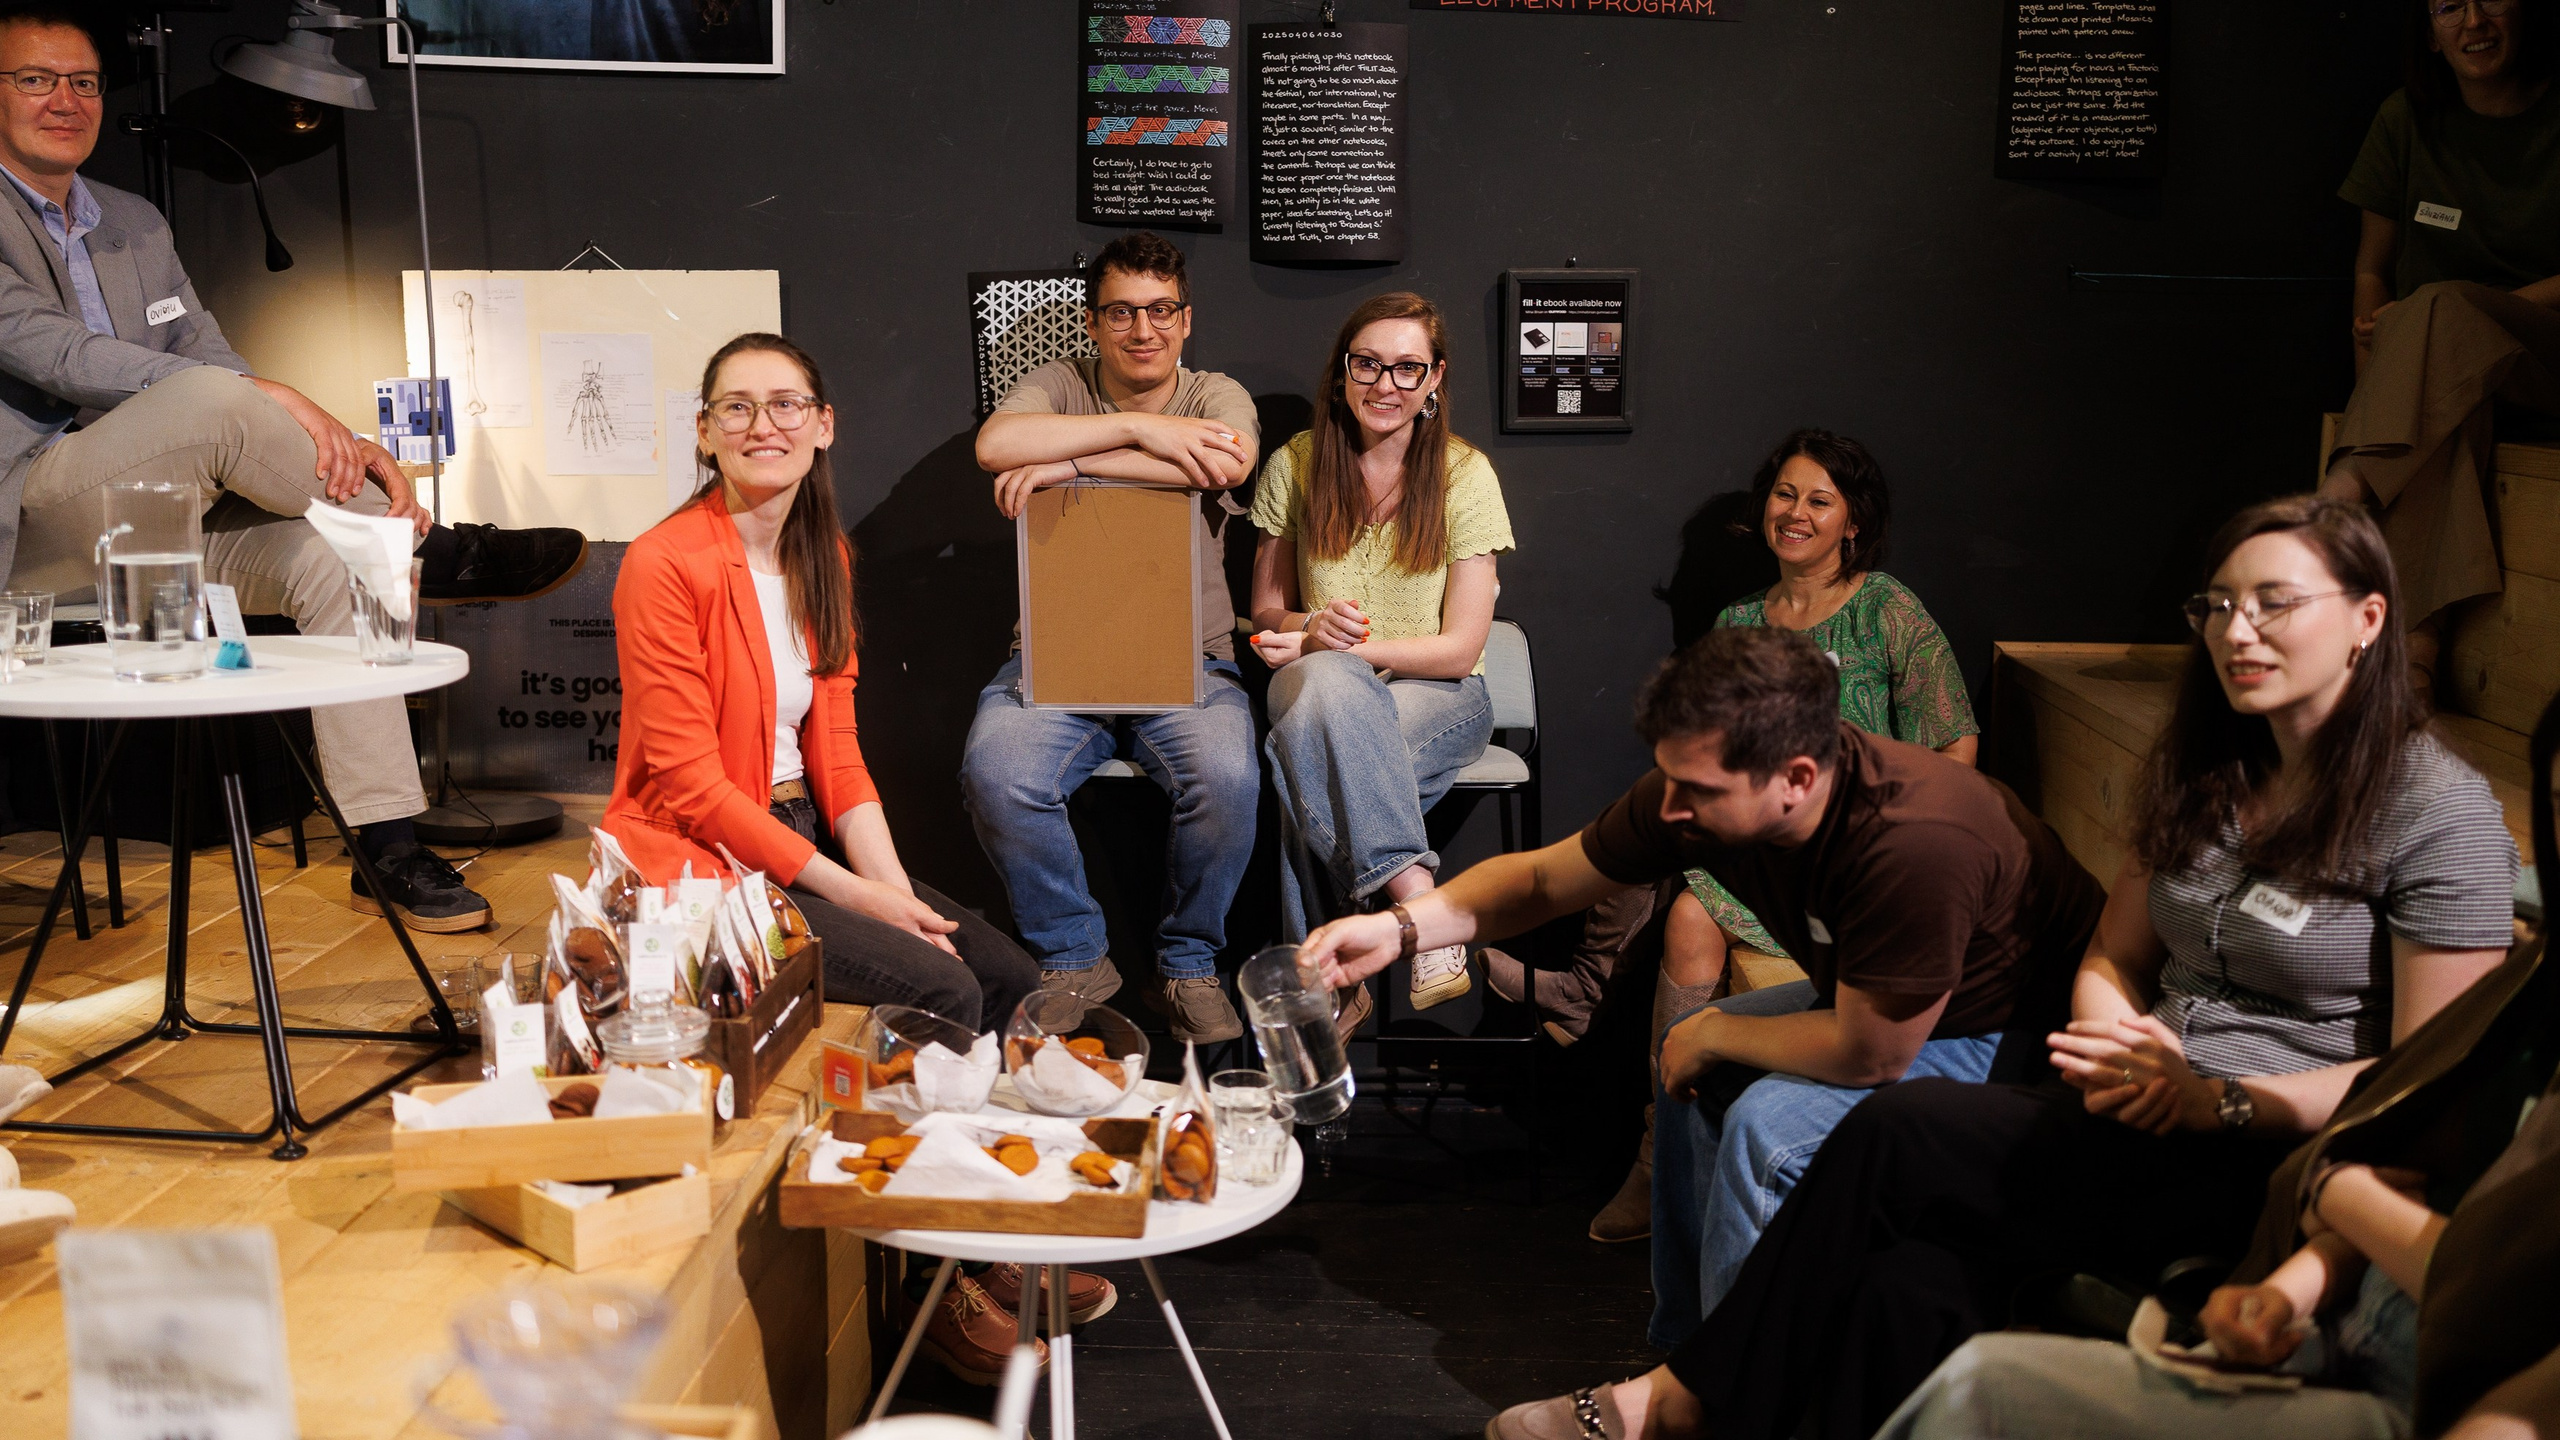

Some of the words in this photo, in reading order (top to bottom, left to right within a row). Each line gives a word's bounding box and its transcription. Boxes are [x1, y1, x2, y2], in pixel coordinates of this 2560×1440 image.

[2020, 4, 2044, 15] pages
[2092, 3, 2135, 14] Templates
[1262, 52, 1288, 63] Finally
[1290, 52, 1320, 64] picking
[1323, 55, 1333, 64] up
[2016, 50, 2033, 59] The
[2039, 65, 2069, 78] playing
[2071, 63, 2087, 72] for
[1294, 78, 1317, 88] going
[2015, 76, 2044, 88] Except
[2086, 76, 2122, 88] listening
[1325, 88, 1380, 98] international,
[1363, 100, 1390, 112] Except
[1262, 115, 1286, 126] maybe
[1289, 150, 1305, 163] only
[1158, 160, 1177, 168] have
[1315, 161, 1345, 173] Perhaps
[1376, 161, 1396, 169] think
[1300, 174, 1325, 184] proper
[1300, 186, 1341, 196] completely
[1297, 197, 1320, 209] utility
[1304, 209, 1316, 217] for
[1263, 221, 1292, 233] Currently
[1296, 220, 1328, 233] listening
[1338, 234, 1366, 244] chapter
[549, 619, 570, 627] THIS
[571, 619, 601, 627] PLACE
[602, 619, 611, 627] IS
[521, 670, 566, 695] it's
[571, 676, 622, 702] goo
[498, 706, 528, 728] to
[535, 710, 587, 728] see
[592, 710, 621, 736] yo
